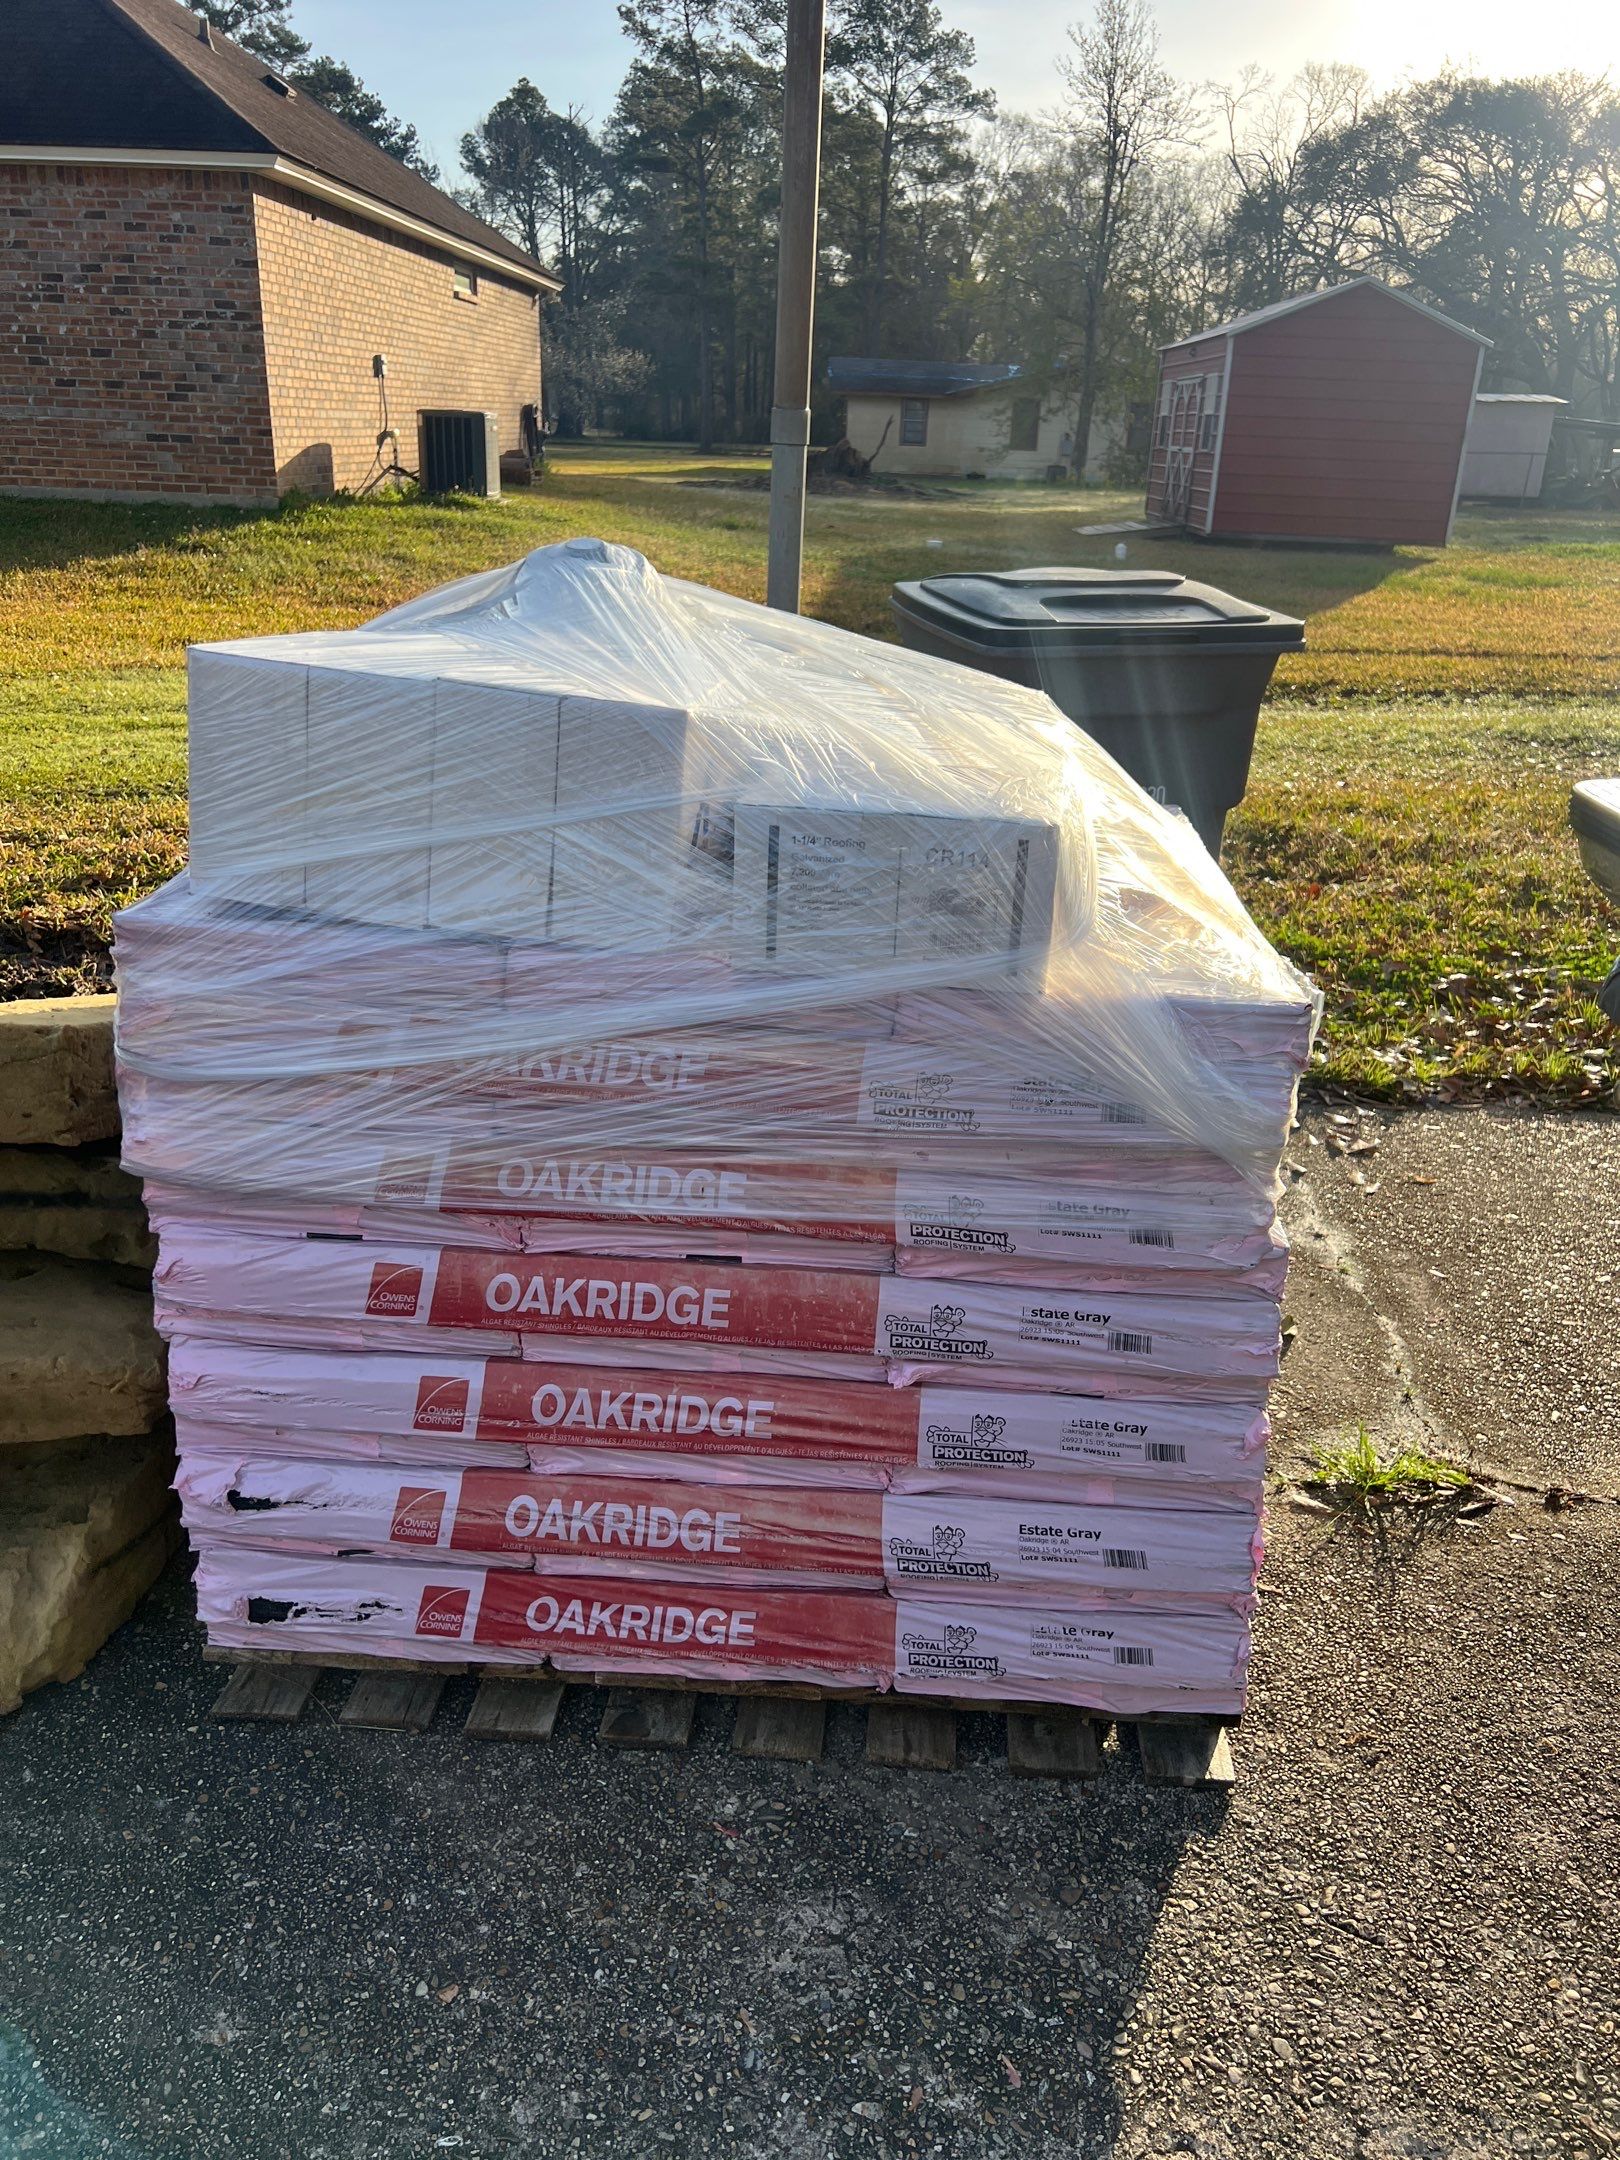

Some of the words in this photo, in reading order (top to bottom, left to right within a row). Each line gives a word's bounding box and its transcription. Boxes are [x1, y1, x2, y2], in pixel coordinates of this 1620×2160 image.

[824, 837, 866, 850] Roofing
[926, 847, 990, 868] CR114
[879, 1090, 912, 1100] TOTAL
[874, 1102, 973, 1122] PROTECTION
[497, 1158, 747, 1210] OAKRIDGE
[912, 1225, 1006, 1246] PROTECTION
[1040, 1228, 1058, 1236] Lot#
[1062, 1230, 1102, 1240] SWS1111
[913, 1238, 949, 1248] ROOFING
[952, 1243, 984, 1252] SYSTEM
[380, 1292, 416, 1302] OWENS
[485, 1272, 731, 1328] OAKRIDGE
[370, 1300, 415, 1311] CORNING
[1021, 1318, 1053, 1327] Oakridge
[1022, 1306, 1071, 1320] state
[1074, 1310, 1111, 1326] Gray
[504, 1319, 537, 1327] RESISTANT
[577, 1324, 612, 1333] BARDEAUX
[894, 1323, 928, 1334] TOTAL
[1020, 1326, 1042, 1334] 26923
[1066, 1329, 1105, 1340] Southwest
[892, 1336, 984, 1354] PROTECTION
[1041, 1336, 1081, 1346] SWS1111
[427, 1405, 463, 1416] OWENS
[531, 1382, 775, 1439] OAKRIDGE
[418, 1414, 462, 1426] CORNING
[1061, 1428, 1094, 1437] Oakridge
[1105, 1431, 1115, 1439] AR
[1114, 1422, 1148, 1436] Gray
[936, 1433, 969, 1444] TOTAL
[1061, 1436, 1083, 1445] 26923
[1106, 1440, 1143, 1450] Southwest
[550, 1434, 584, 1443] RESISTANT
[622, 1438, 656, 1448] BARDEAUX
[658, 1440, 692, 1449] RÉSISTANT
[704, 1442, 760, 1454] DÉVELOPPEMENT
[798, 1448, 819, 1458] TEJAS
[820, 1450, 862, 1460] RESISTENTES
[1082, 1448, 1121, 1458] SWS1111
[934, 1446, 1027, 1463] PROTECTION
[403, 1517, 438, 1528] OWENS
[504, 1494, 742, 1553] OAKRIDGE
[394, 1526, 436, 1539] CORNING
[1019, 1524, 1063, 1537] Estate
[1067, 1528, 1102, 1541] Gray
[1019, 1536, 1049, 1545] Oakridge
[899, 1546, 932, 1557] TOTAL
[1064, 1548, 1100, 1557] Southwest
[1041, 1555, 1078, 1564] SWS1111
[898, 1559, 990, 1576] PROTECTION
[429, 1611, 462, 1622] OWENS
[525, 1596, 757, 1647] OAKRIDGE
[420, 1620, 460, 1632] CORNING
[911, 1640, 943, 1651] TOTAL
[1032, 1642, 1053, 1650] 26923
[1076, 1644, 1111, 1653] Southwest
[909, 1654, 997, 1671] PROTECTION
